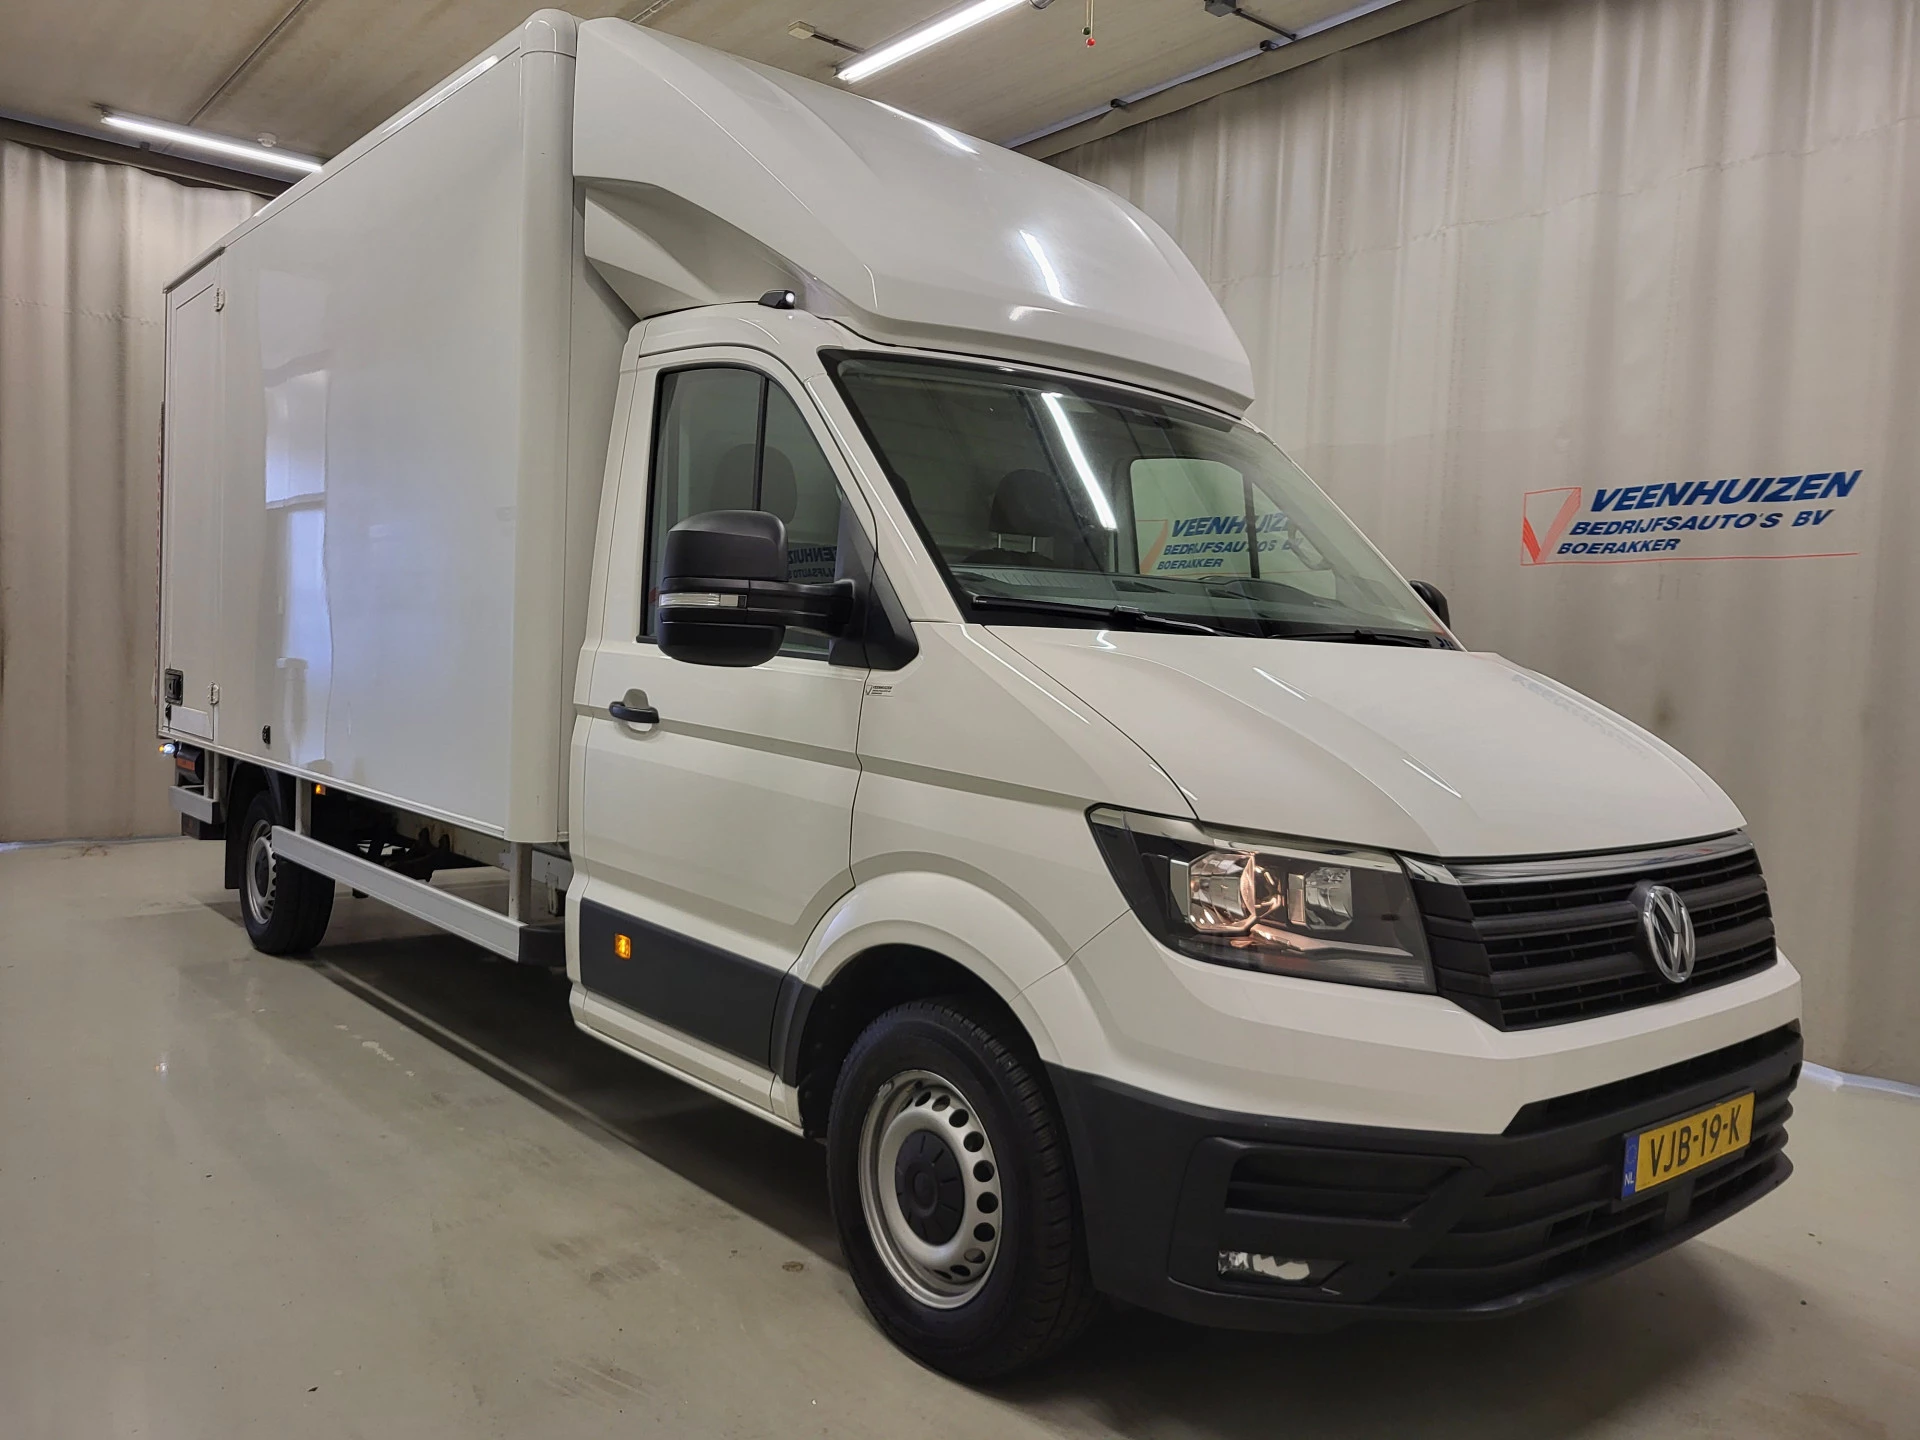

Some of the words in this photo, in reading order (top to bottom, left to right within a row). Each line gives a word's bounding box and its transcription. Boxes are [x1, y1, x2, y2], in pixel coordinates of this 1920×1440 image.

[1590, 470, 1863, 512] VEENHUIZEN
[1569, 512, 1783, 535] BEDRIJFSAUTO'S
[1791, 509, 1835, 527] BV
[1557, 538, 1681, 555] BOERAKKER
[1650, 1104, 1742, 1177] VJB-19-K
[1624, 1172, 1635, 1187] NL
